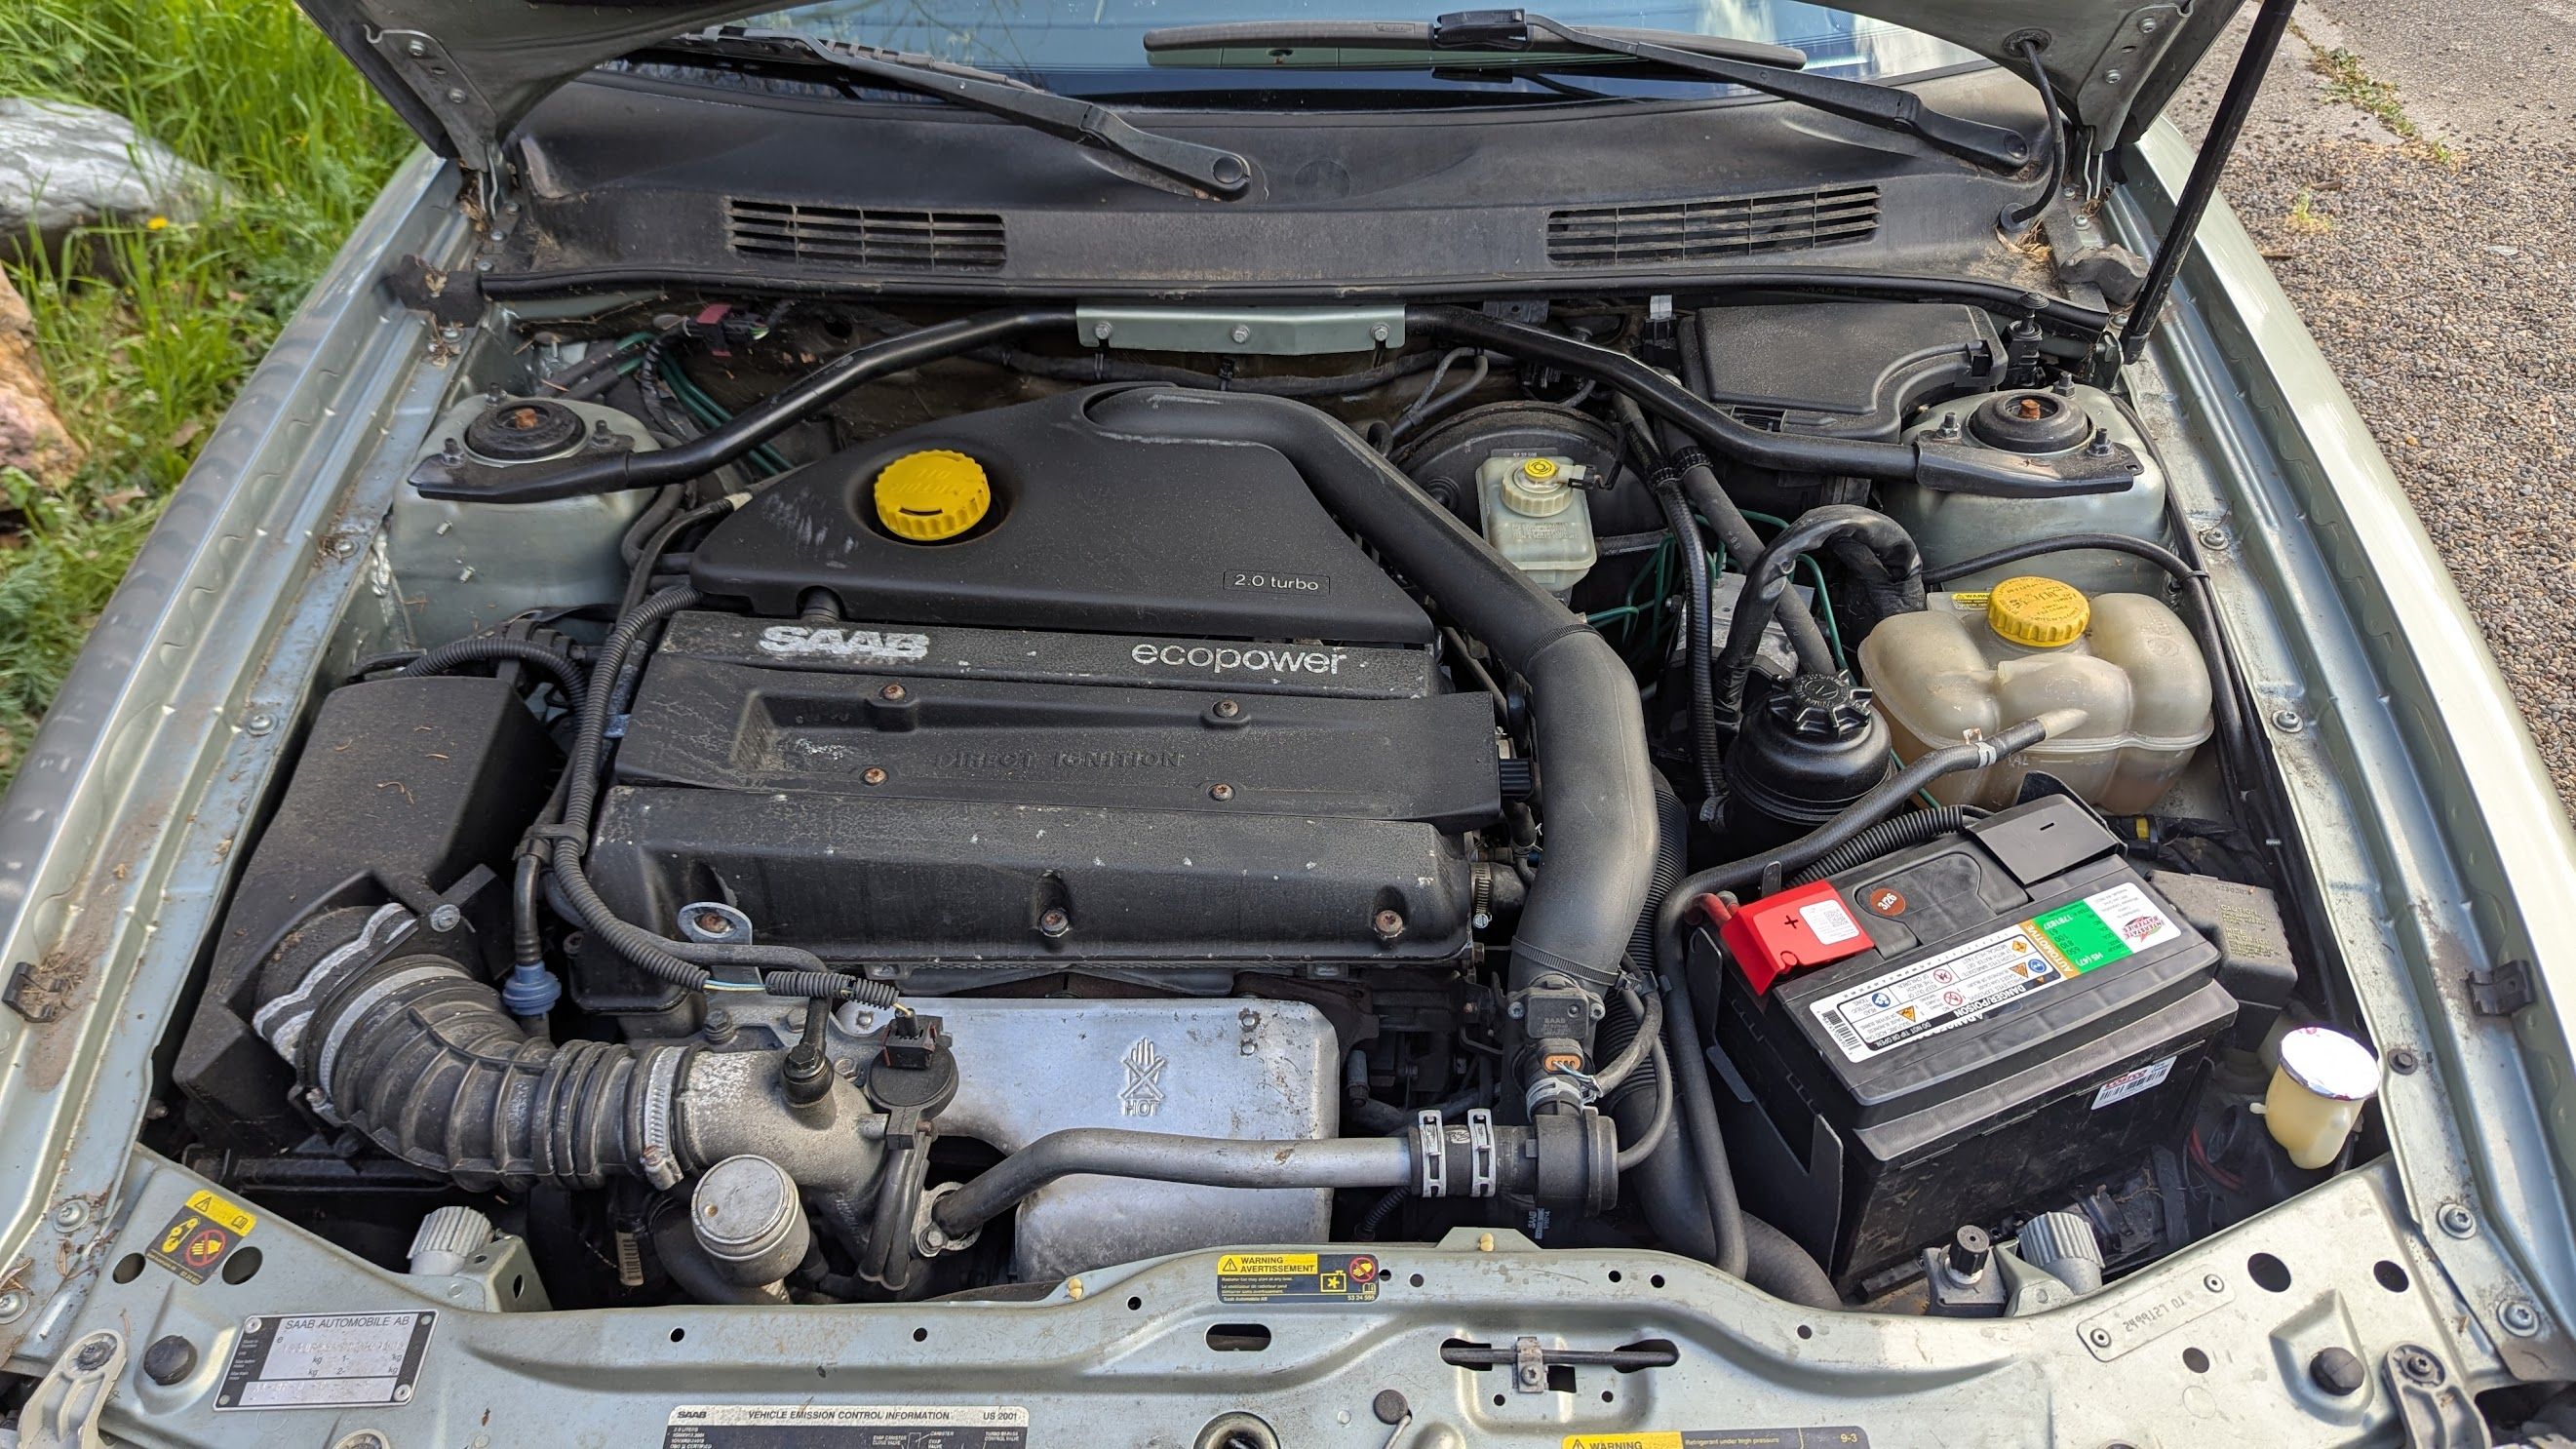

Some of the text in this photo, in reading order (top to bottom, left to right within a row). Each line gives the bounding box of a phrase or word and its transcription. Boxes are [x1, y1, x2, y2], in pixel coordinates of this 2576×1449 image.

[1234, 573, 1319, 591] 2.0 turbo
[759, 625, 930, 658] SAAB
[1132, 644, 1347, 675] ecopower
[935, 750, 1183, 768] DIRECT IGNITION
[1877, 893, 1897, 911] 3/26
[2052, 933, 2068, 942] 100
[2058, 939, 2074, 949] 810
[2025, 924, 2072, 972] AUTOMOTIVE
[2064, 946, 2081, 956] 650
[1952, 984, 2026, 1017] DANGER/POISON
[1897, 1029, 1910, 1038] TIP
[1908, 1024, 1922, 1033] NOT
[1125, 1100, 1159, 1116] HOT
[285, 1316, 410, 1329] SAAB AUTOMOBILE AB
[389, 1366, 398, 1375] kg
[748, 1411, 950, 1421] VEHICLE EMISSION CONTROL INFORMATION
[1840, 1433, 1857, 1442] 9-3
